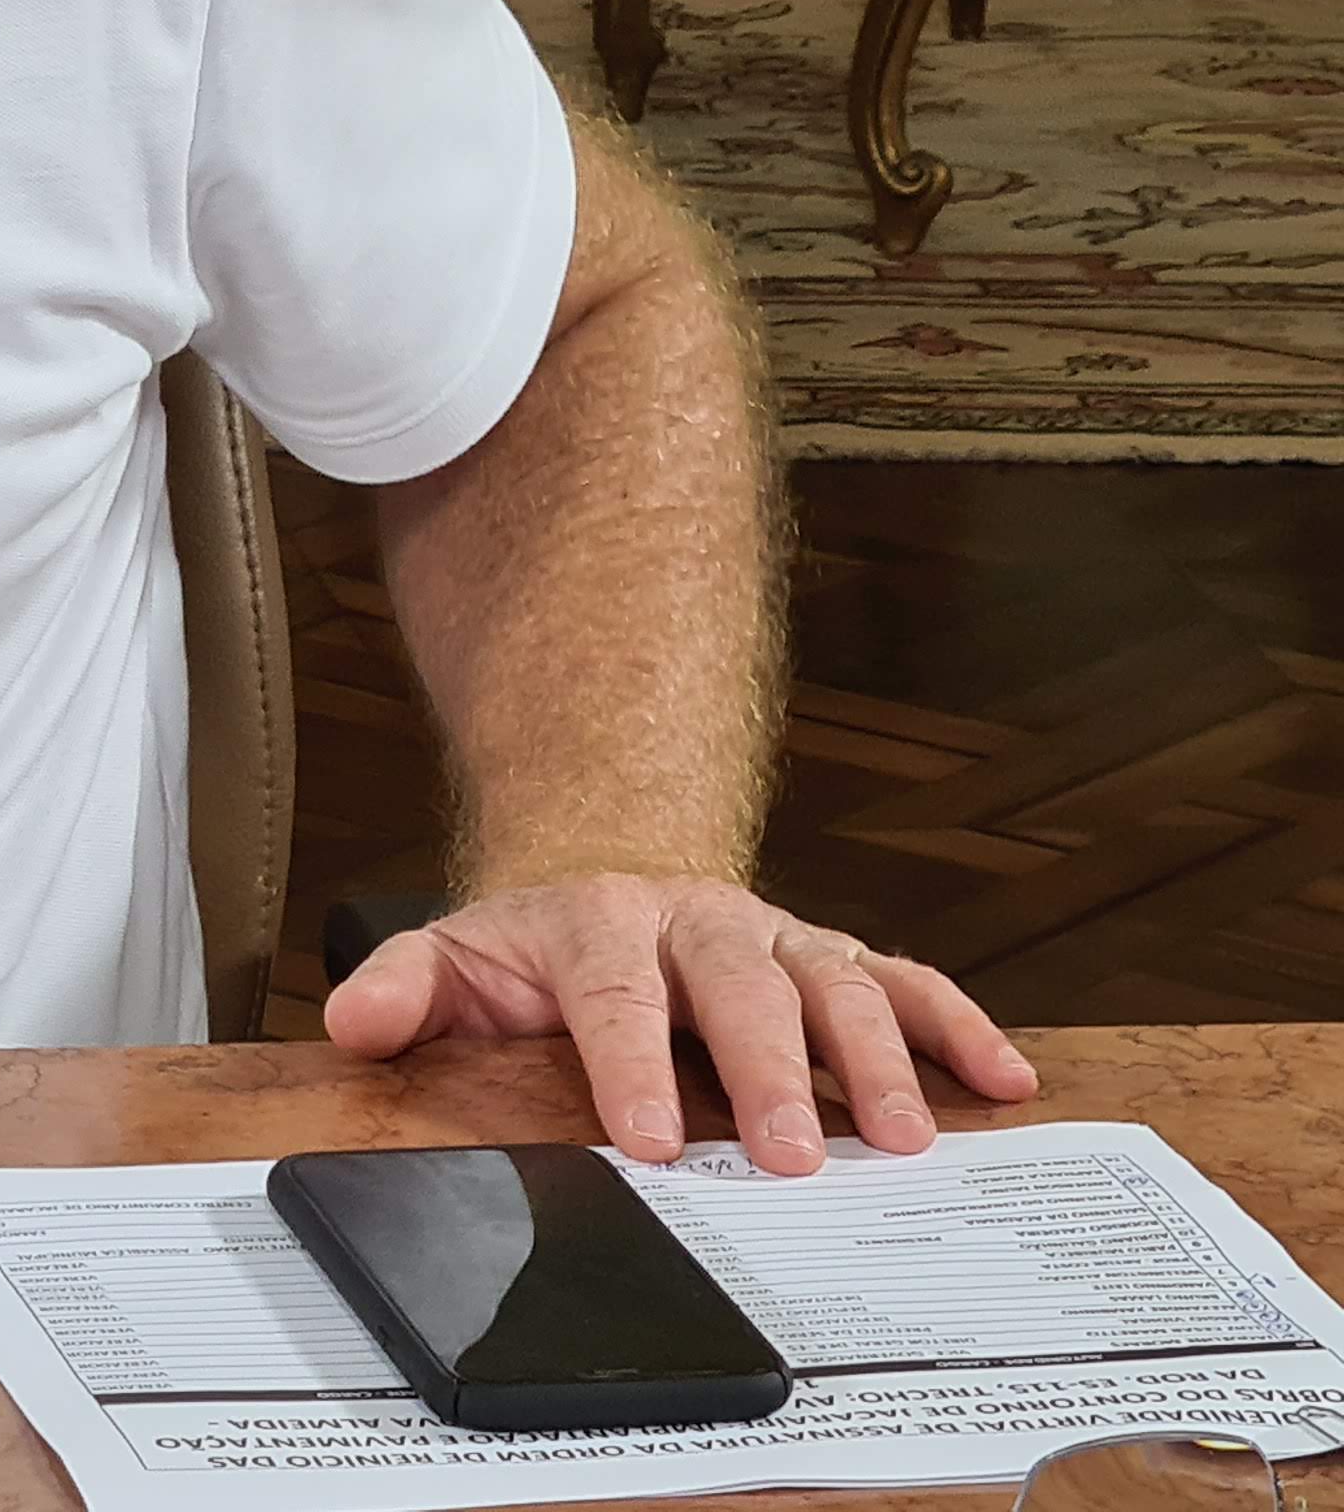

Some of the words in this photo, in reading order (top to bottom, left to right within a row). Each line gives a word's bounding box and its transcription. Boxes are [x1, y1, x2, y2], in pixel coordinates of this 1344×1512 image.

[1124, 1372, 1210, 1385] ROD.
[1212, 1369, 1266, 1381] DA
[846, 1387, 992, 1403] TRECHO:
[1177, 1390, 1228, 1401] DO
[1234, 1389, 1344, 1403] OBRAS
[975, 1391, 1167, 1414] CONTORNO
[921, 1405, 966, 1417] DE
[965, 1414, 1112, 1433] VIRTUAL
[1116, 1410, 1303, 1425] OLENIDADE
[228, 1418, 379, 1430] ALMEIDA
[914, 1423, 960, 1434] DE
[154, 1435, 430, 1451] PAVIMENTAÇÃO
[439, 1434, 459, 1446] E
[690, 1424, 902, 1450] ASSINATURA
[496, 1445, 625, 1462] ORDEM
[632, 1442, 683, 1454] DA
[208, 1456, 275, 1468] DAS
[440, 1452, 488, 1463] DE
